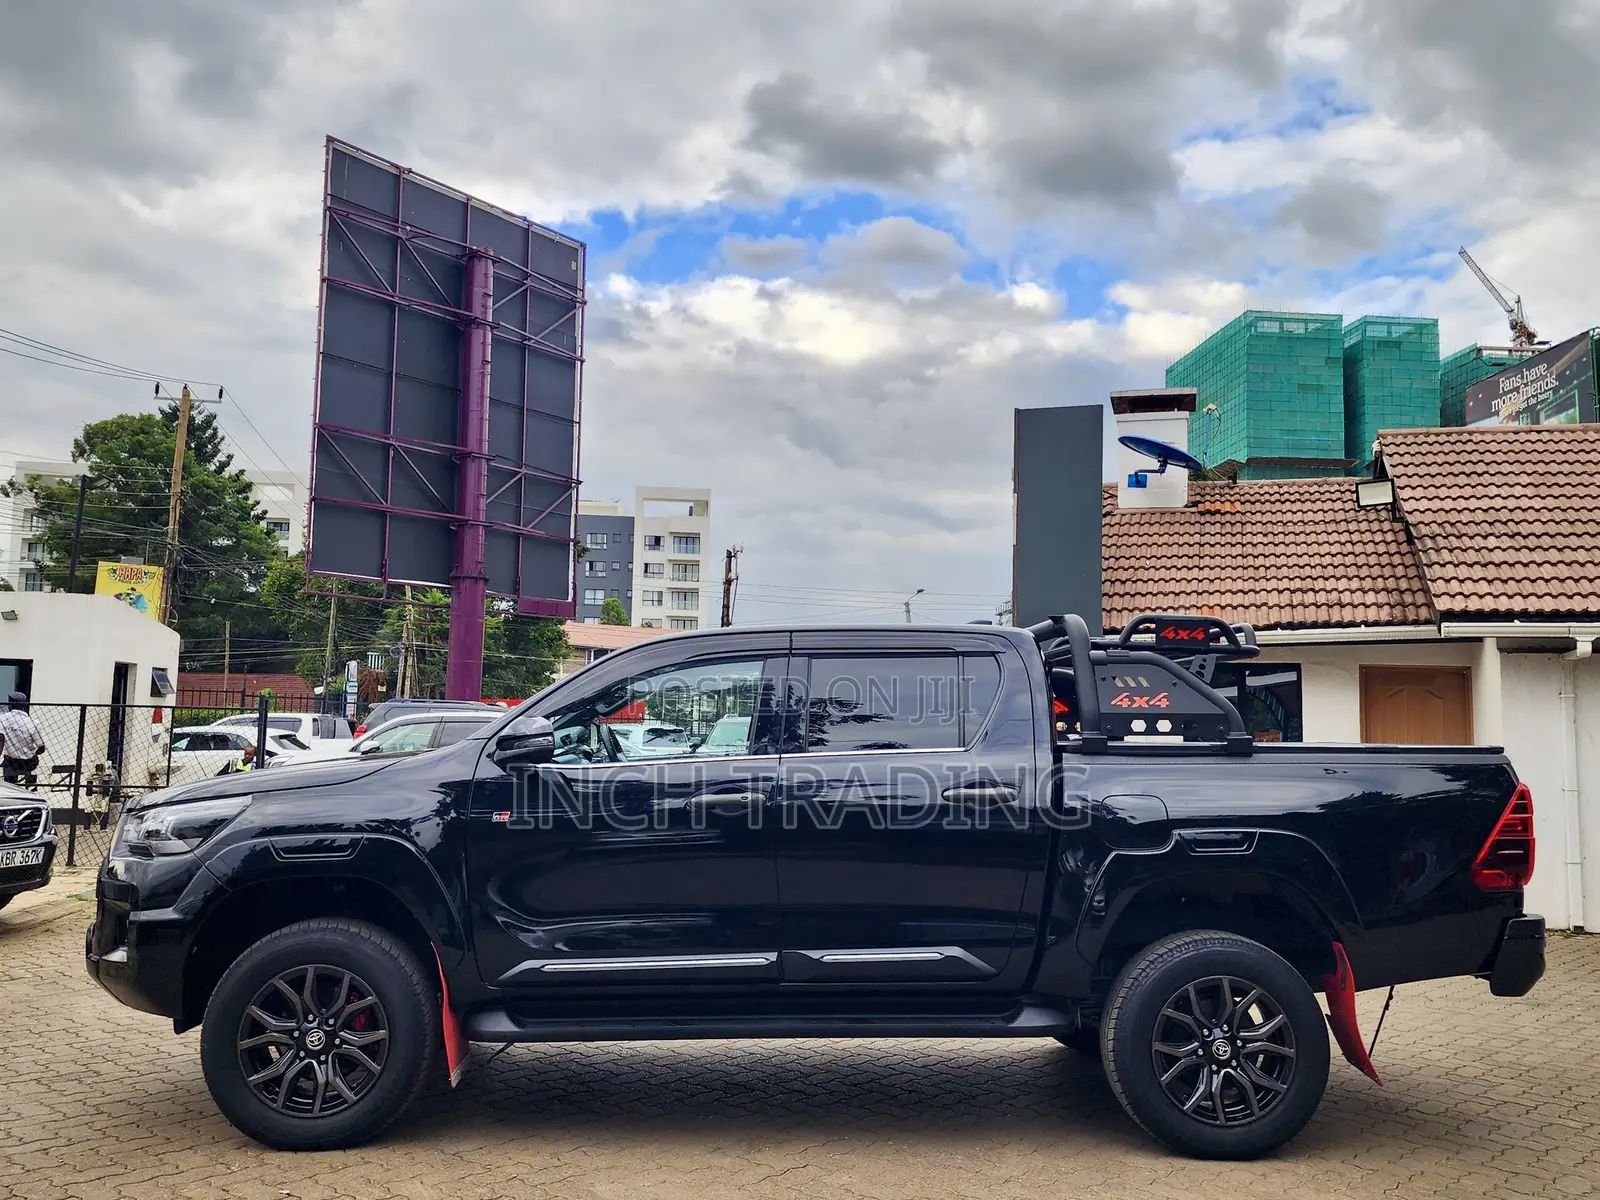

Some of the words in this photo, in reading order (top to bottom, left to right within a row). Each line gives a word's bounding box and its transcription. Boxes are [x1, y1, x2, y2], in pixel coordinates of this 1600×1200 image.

[1499, 376, 1522, 394] Fans
[1523, 363, 1548, 383] have
[1491, 393, 1518, 412] more
[1519, 372, 1559, 400] friends.
[1160, 625, 1206, 641] 4x4
[1111, 692, 1170, 708] 4x4
[19, 849, 42, 864] 367K
